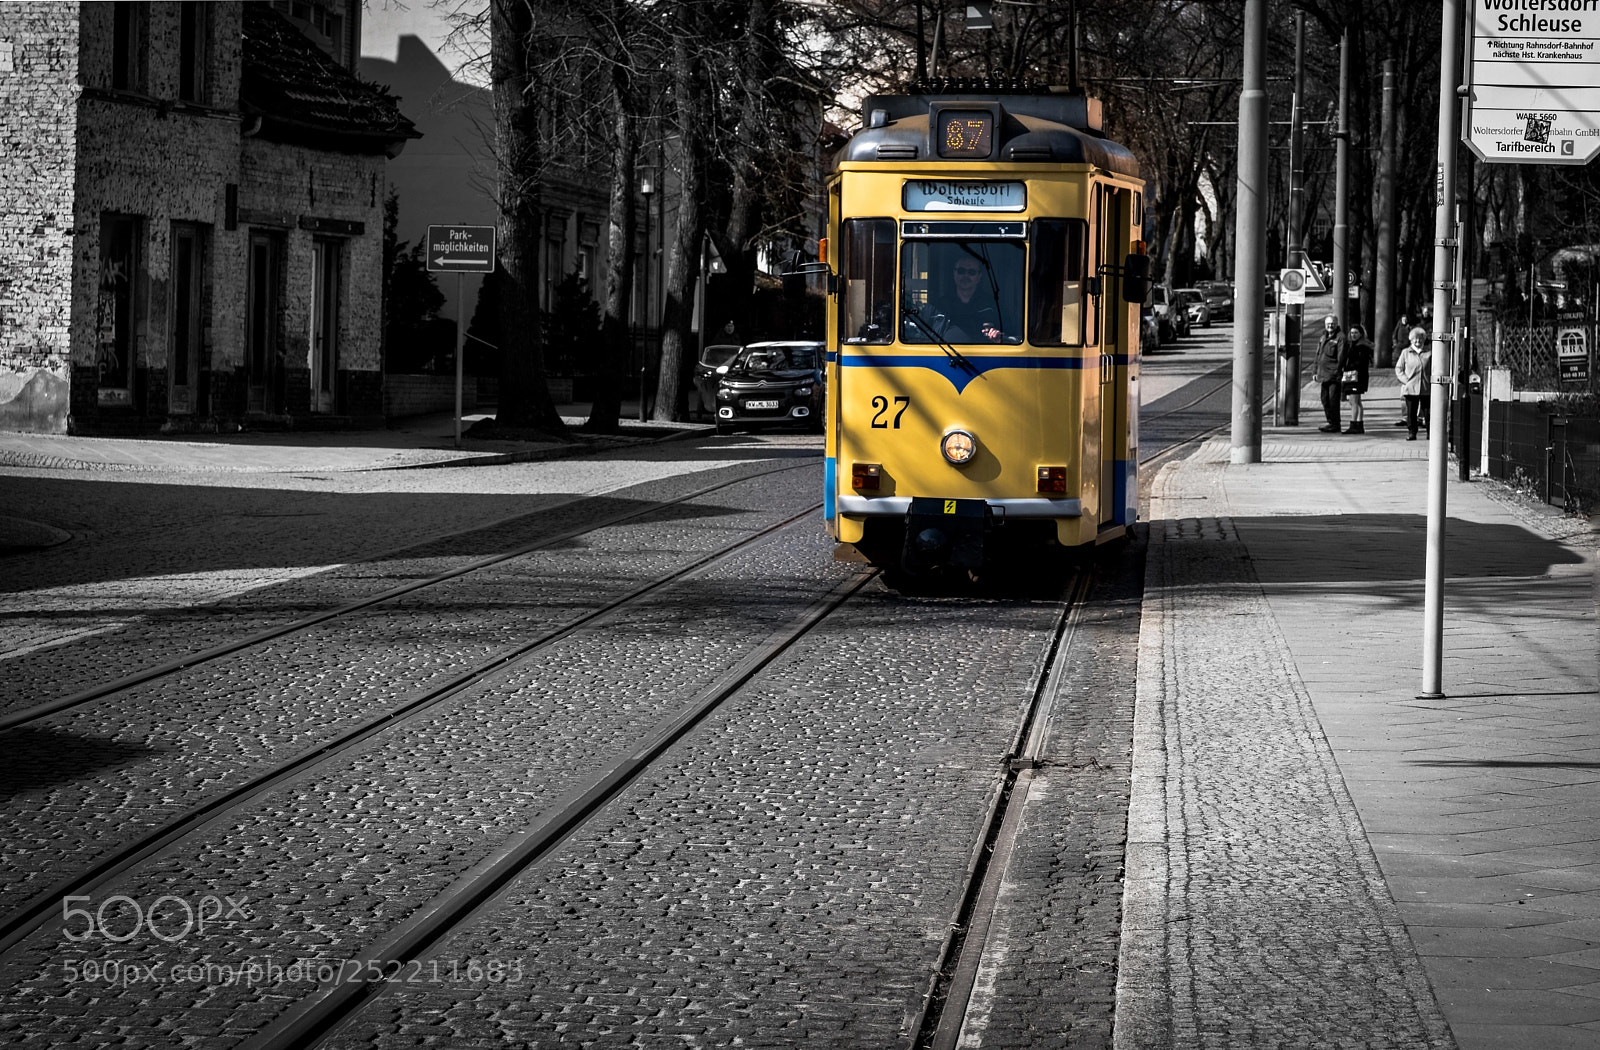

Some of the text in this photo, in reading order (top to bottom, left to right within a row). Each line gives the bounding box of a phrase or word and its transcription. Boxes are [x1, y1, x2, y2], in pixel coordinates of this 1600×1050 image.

[1498, 13, 1582, 32] Schleuse
[1493, 41, 1594, 50] Richtung Rahnsdorf-Bahnhof
[946, 120, 984, 149] 87
[1473, 127, 1523, 135] Woltersdorfer
[1496, 142, 1572, 154] Tarifbereich C
[449, 229, 473, 240] Park-
[433, 241, 489, 254] möglichkeiten
[871, 395, 910, 429] 27
